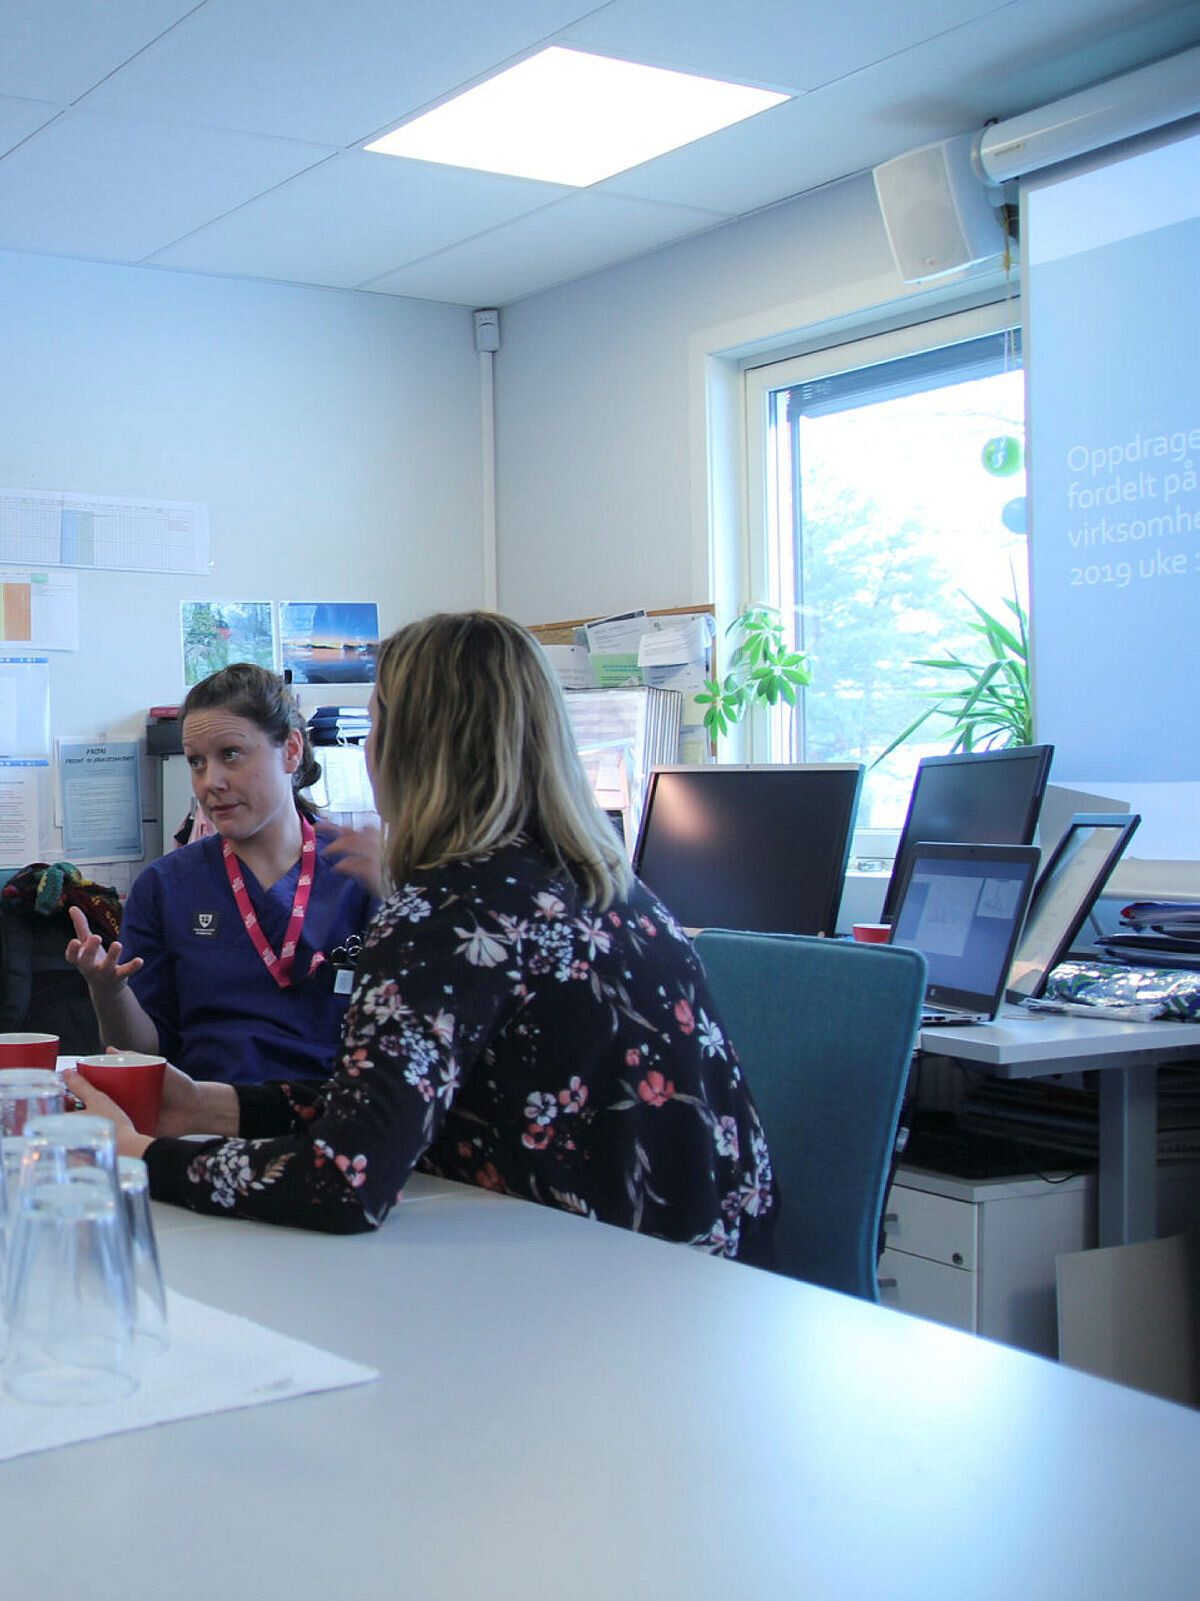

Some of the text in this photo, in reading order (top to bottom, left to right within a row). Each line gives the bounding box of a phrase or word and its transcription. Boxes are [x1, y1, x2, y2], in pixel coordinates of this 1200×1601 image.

[1067, 429, 1200, 476] Oppdrage
[1068, 460, 1197, 509] fordelt på
[1070, 562, 1132, 587] 2019
[1139, 548, 1187, 577] uke
